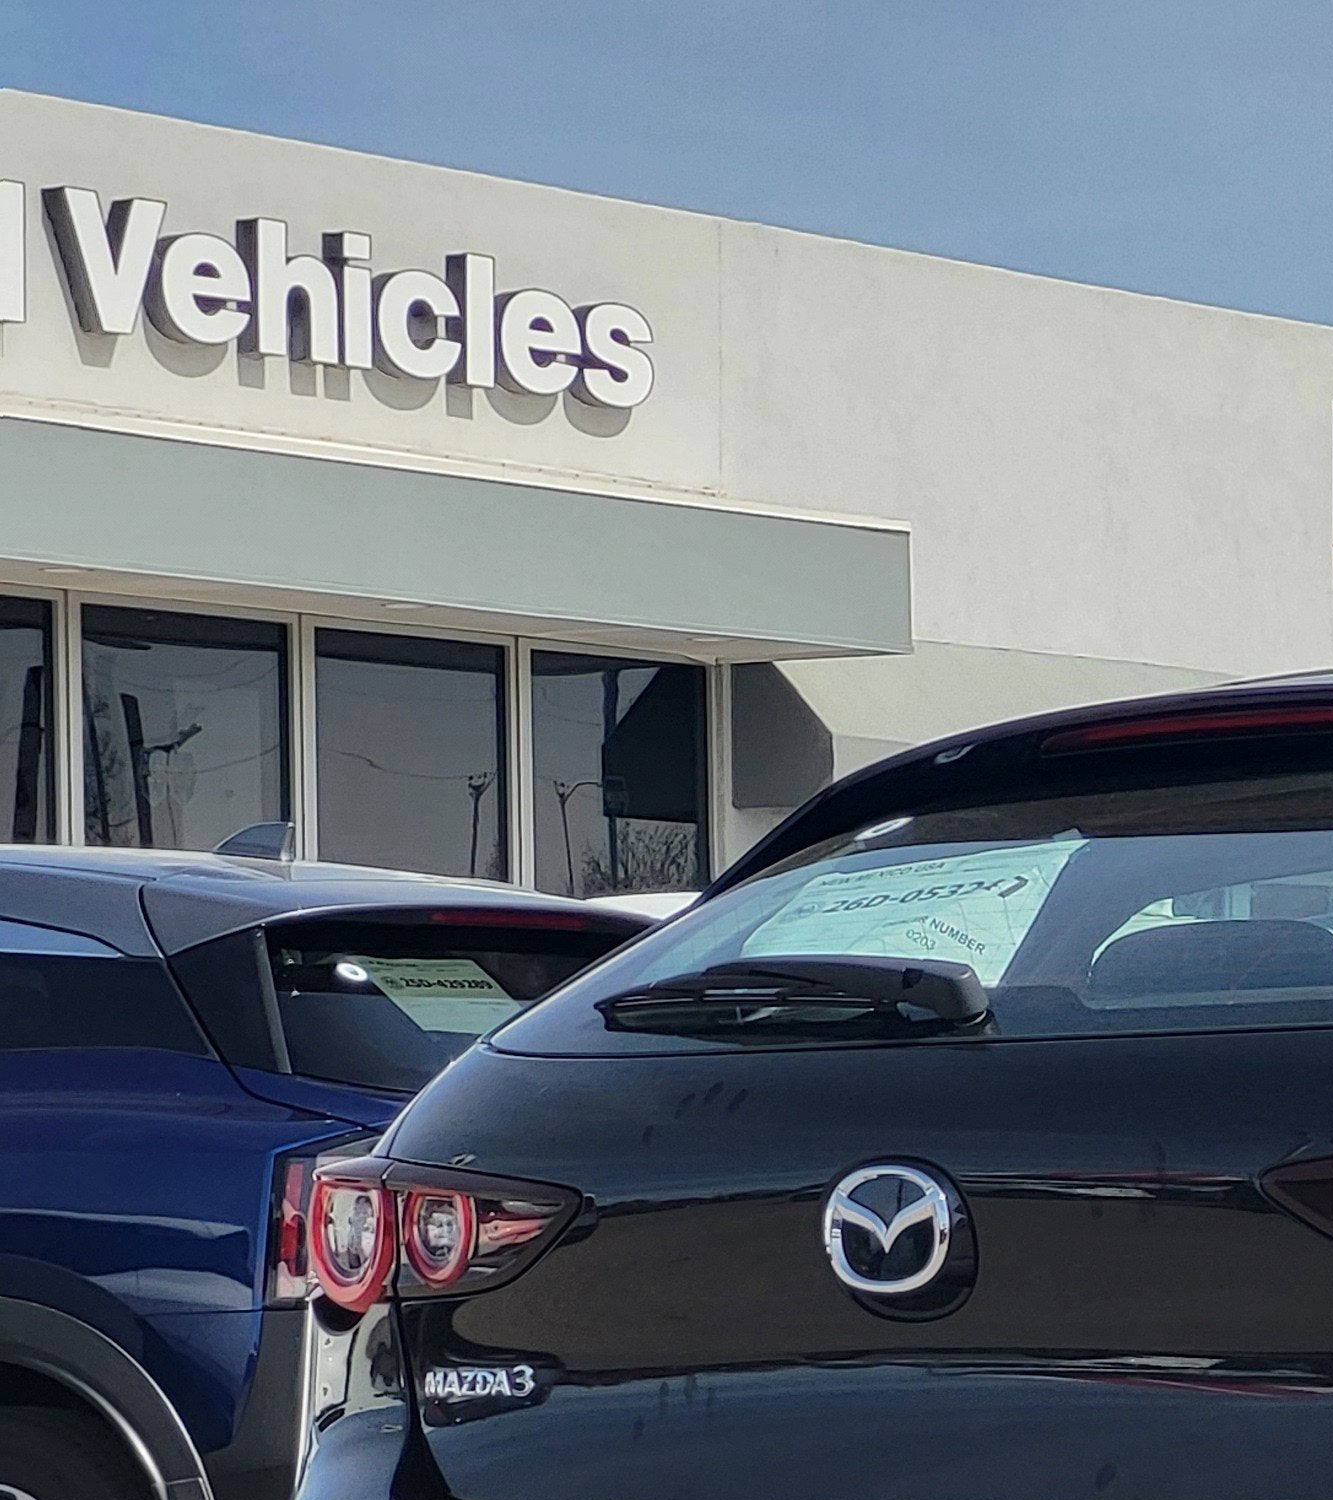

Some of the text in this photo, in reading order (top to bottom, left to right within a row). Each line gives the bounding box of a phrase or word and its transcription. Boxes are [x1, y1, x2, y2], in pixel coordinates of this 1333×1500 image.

[42, 186, 654, 408] Vehicles
[906, 929, 936, 950] 0203
[930, 918, 986, 955] NUMBER
